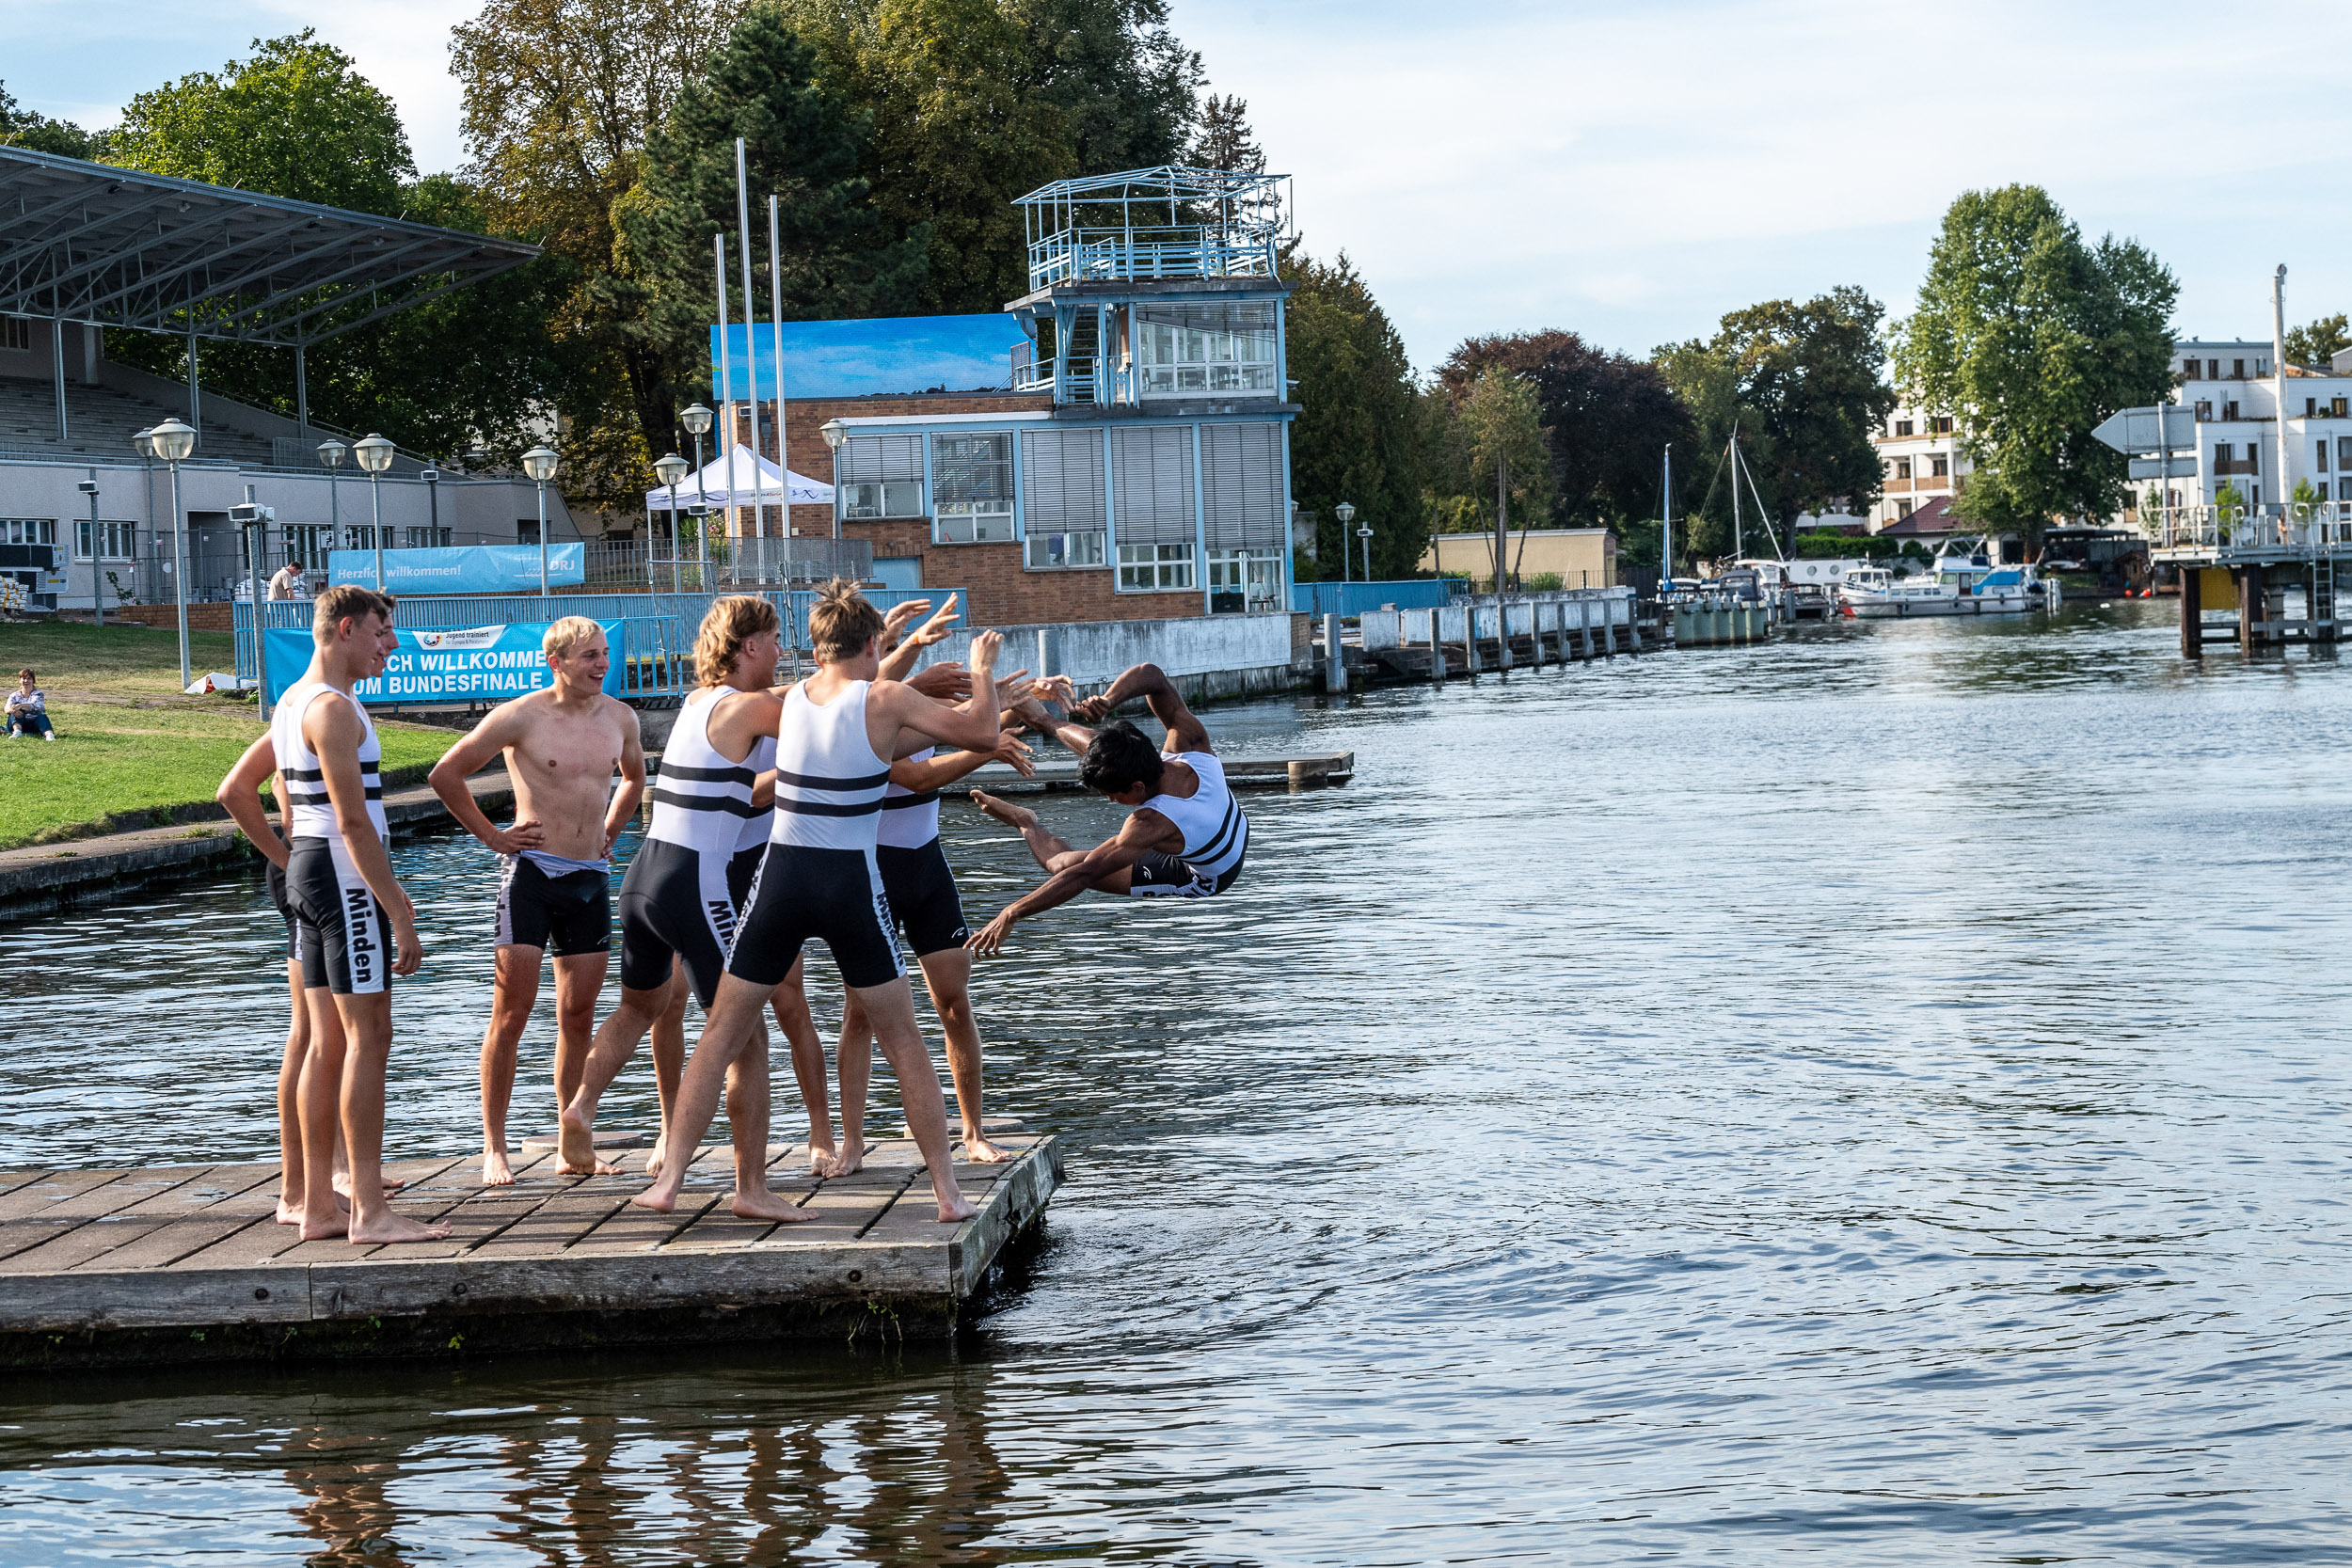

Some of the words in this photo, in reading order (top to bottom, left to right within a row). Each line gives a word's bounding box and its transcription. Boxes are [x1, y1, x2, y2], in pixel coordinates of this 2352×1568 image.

[338, 567, 377, 579] Herzlic
[387, 564, 461, 578] willkommen!
[549, 560, 575, 571] DRJ
[420, 649, 547, 672] WILLKOMME
[353, 676, 381, 695] UM
[389, 671, 543, 694] BUNDESFINALE
[345, 888, 376, 984] Minden
